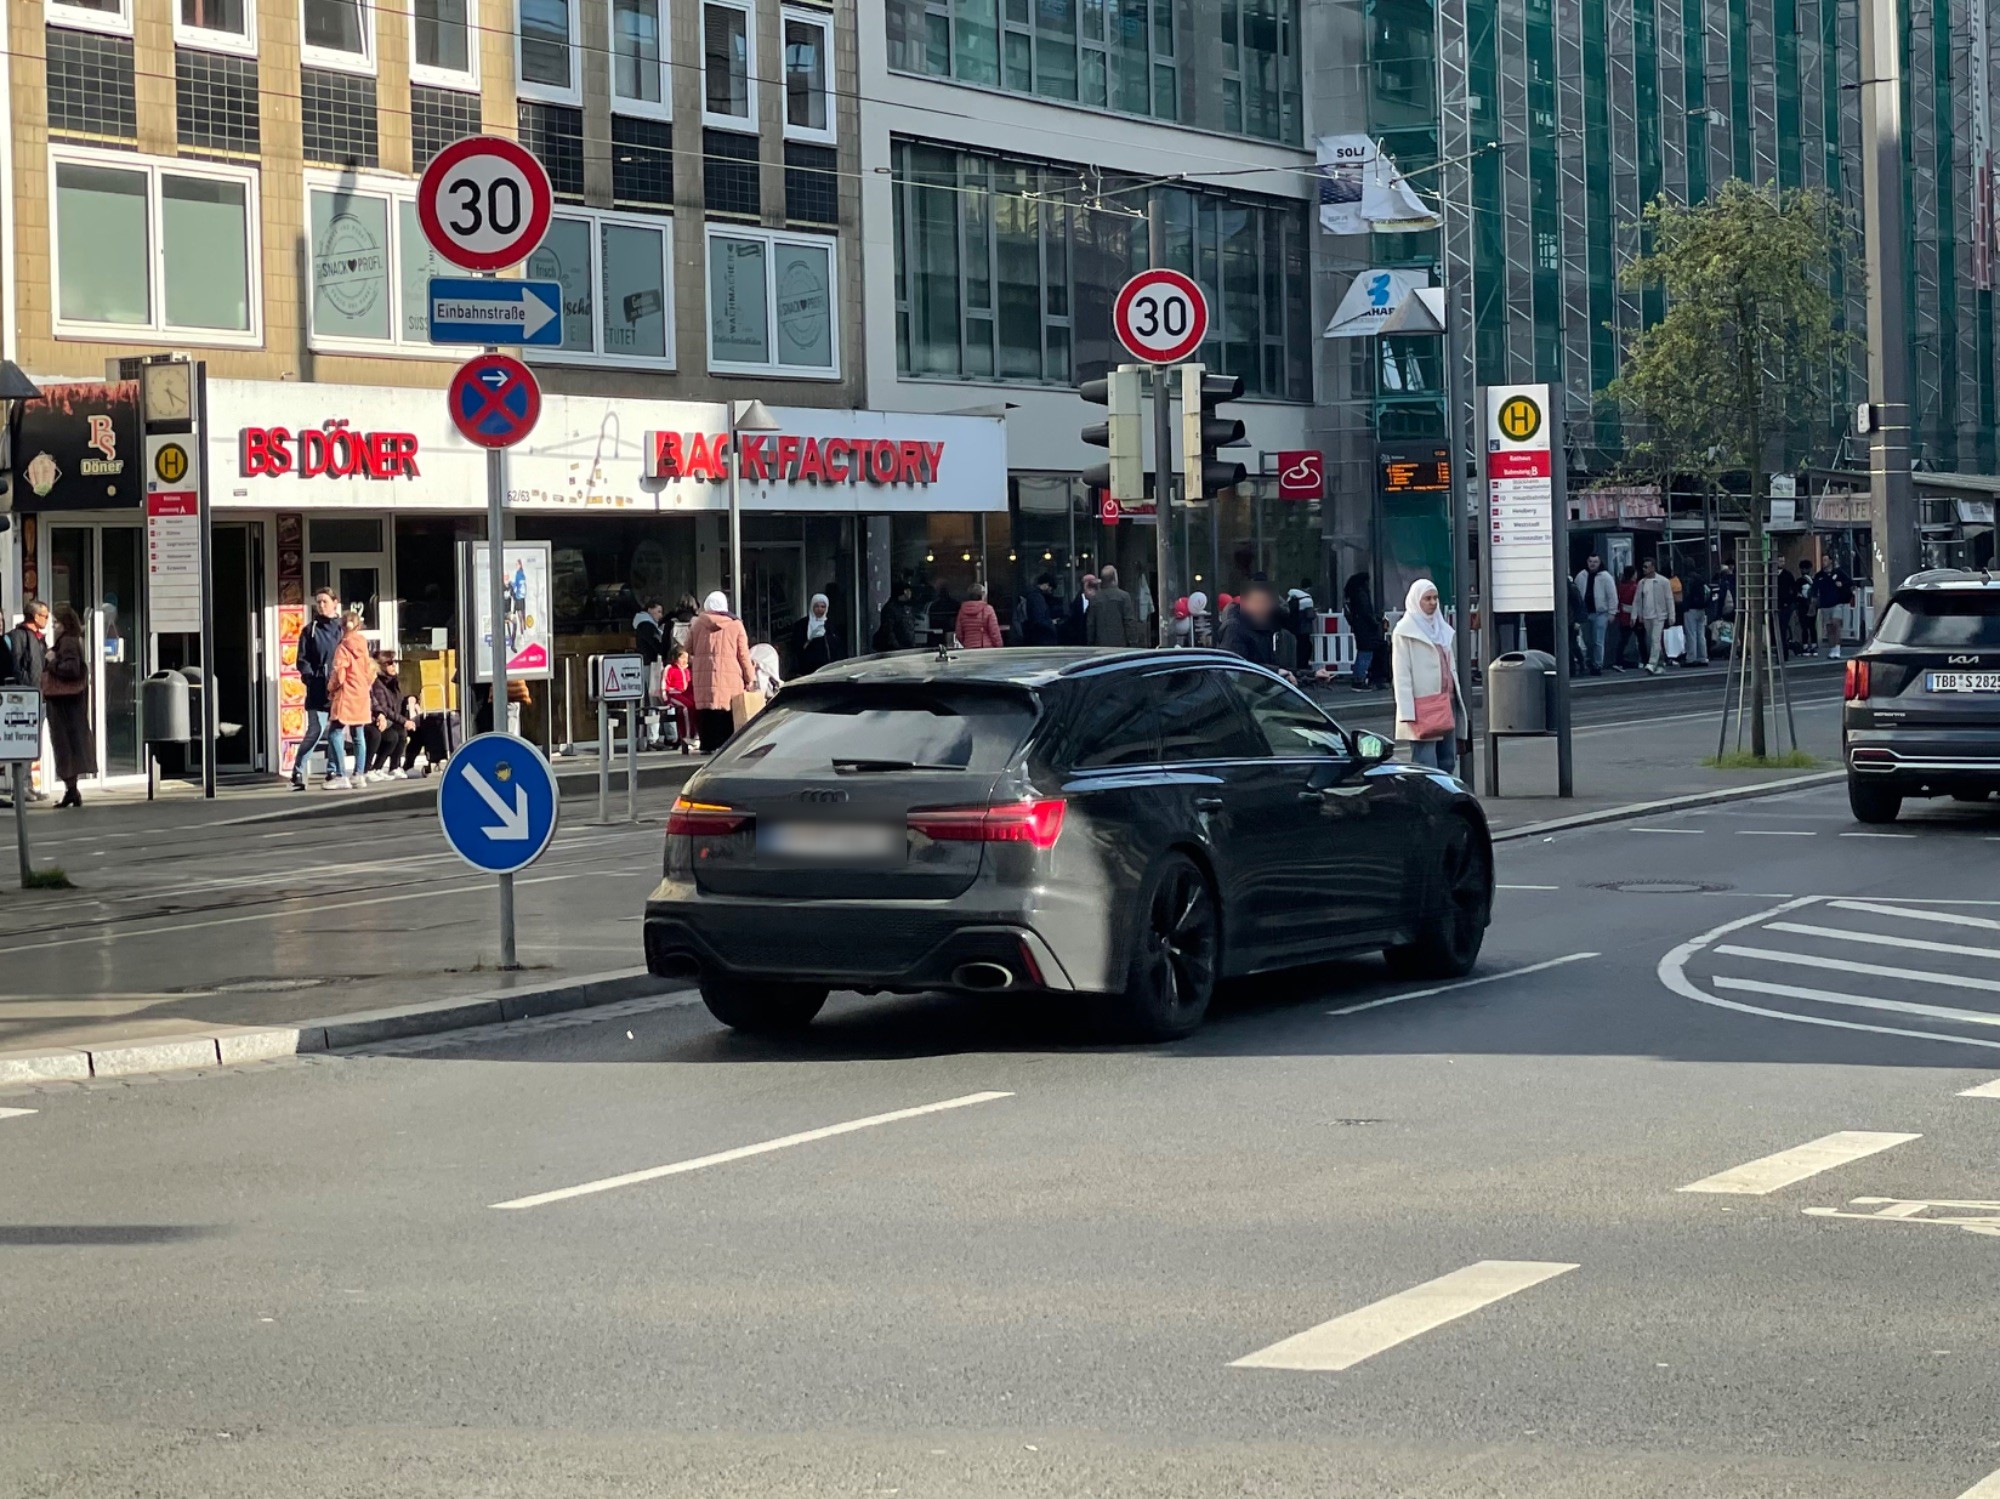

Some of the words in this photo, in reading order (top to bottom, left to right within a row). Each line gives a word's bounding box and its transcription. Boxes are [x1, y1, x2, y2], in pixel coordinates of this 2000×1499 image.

[449, 177, 521, 236] 30
[321, 258, 348, 278] SNACK
[437, 303, 526, 320] Einbahnstraße
[1135, 295, 1187, 337] 30
[240, 427, 292, 478] BS
[300, 419, 420, 480] DÖNER
[648, 431, 945, 485] BACK-FACTORY
[81, 459, 123, 475] Döner
[507, 489, 530, 502] 62/63
[1935, 675, 1956, 688] TBB
[1965, 675, 1973, 688] S
